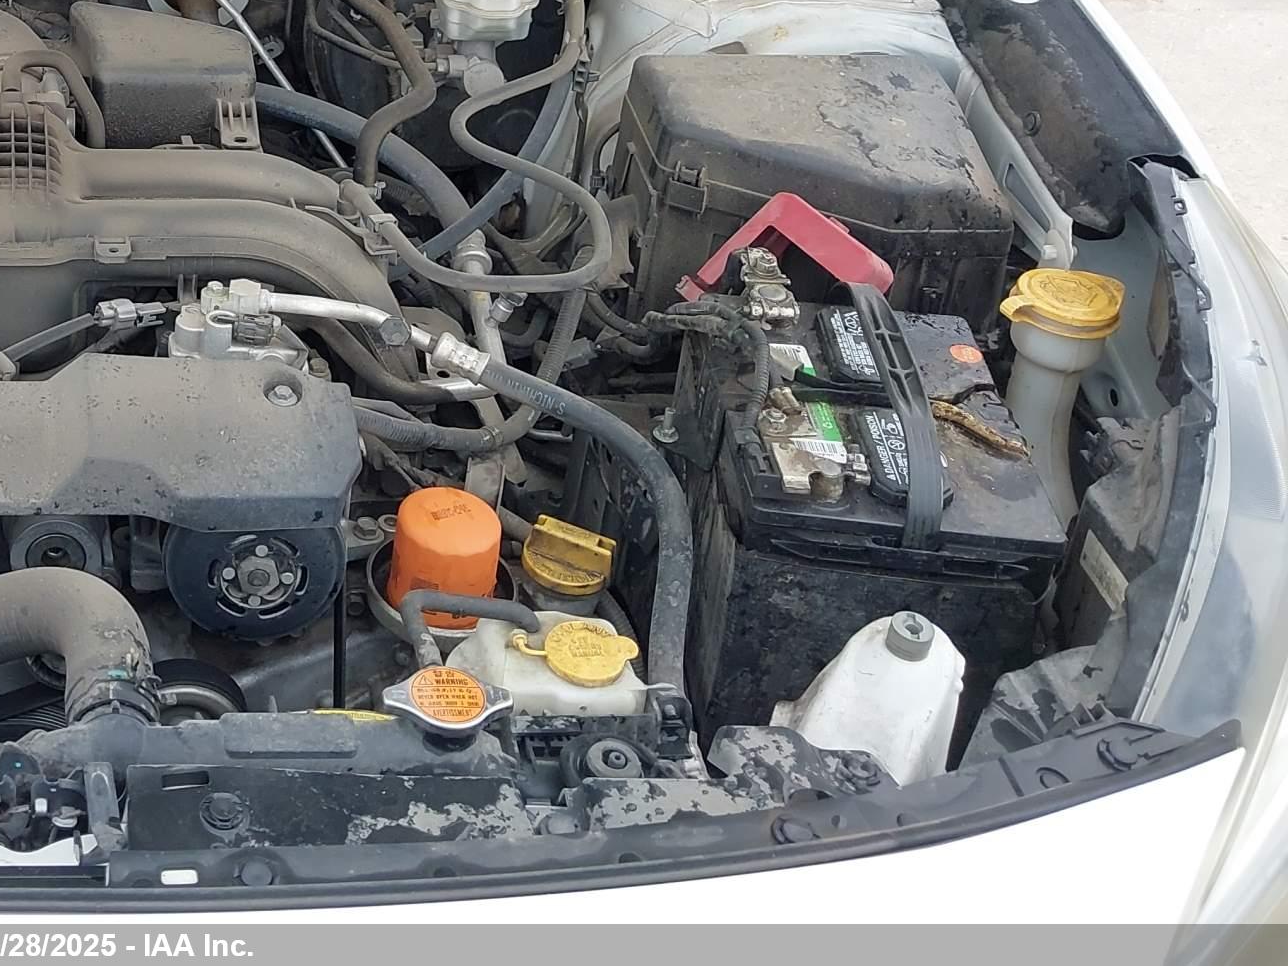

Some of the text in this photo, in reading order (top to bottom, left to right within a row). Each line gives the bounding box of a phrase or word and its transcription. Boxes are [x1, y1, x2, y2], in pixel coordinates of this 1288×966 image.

[865, 415, 882, 440] POISON
[877, 445, 895, 474] DANGER
[435, 678, 469, 686] WARNING
